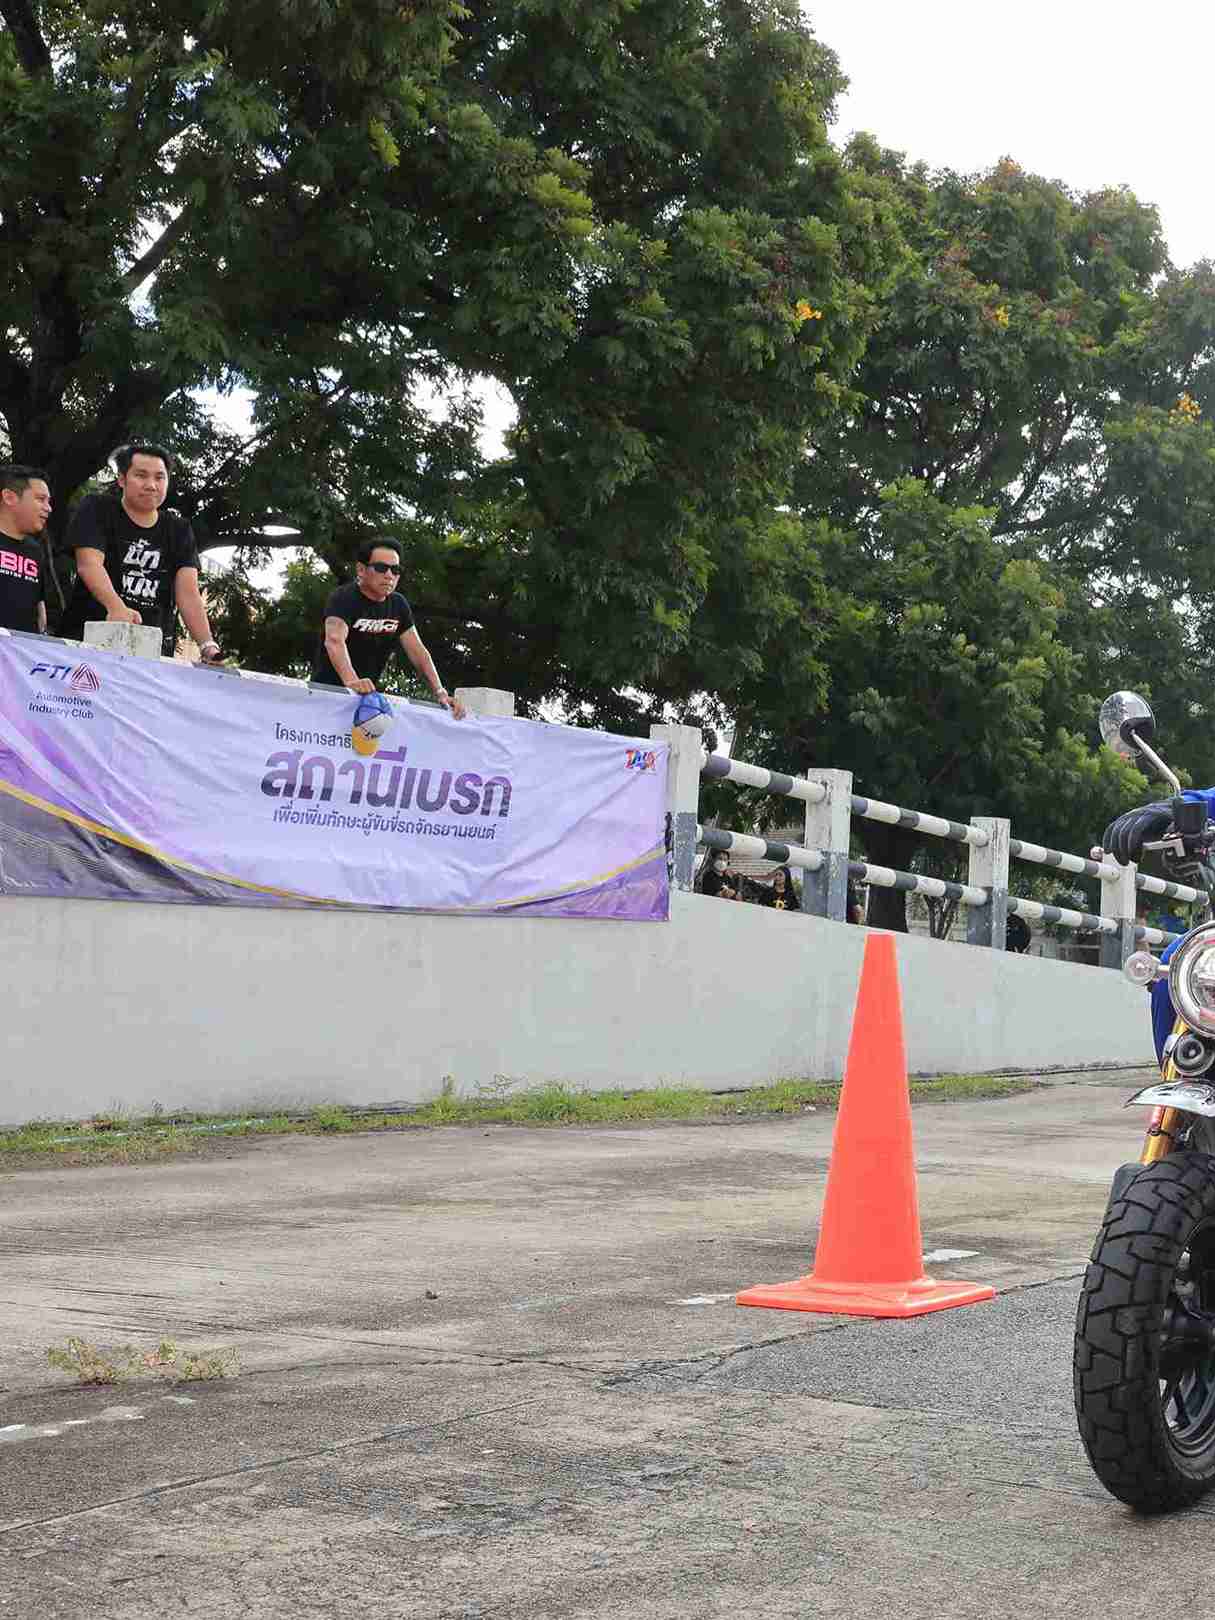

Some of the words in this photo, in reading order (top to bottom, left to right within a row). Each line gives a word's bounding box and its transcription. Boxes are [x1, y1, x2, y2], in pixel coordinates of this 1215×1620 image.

[0, 550, 38, 577] BIG
[30, 663, 72, 680] FTI
[72, 708, 94, 719] Club
[260, 745, 512, 817] สถานีเบรก
